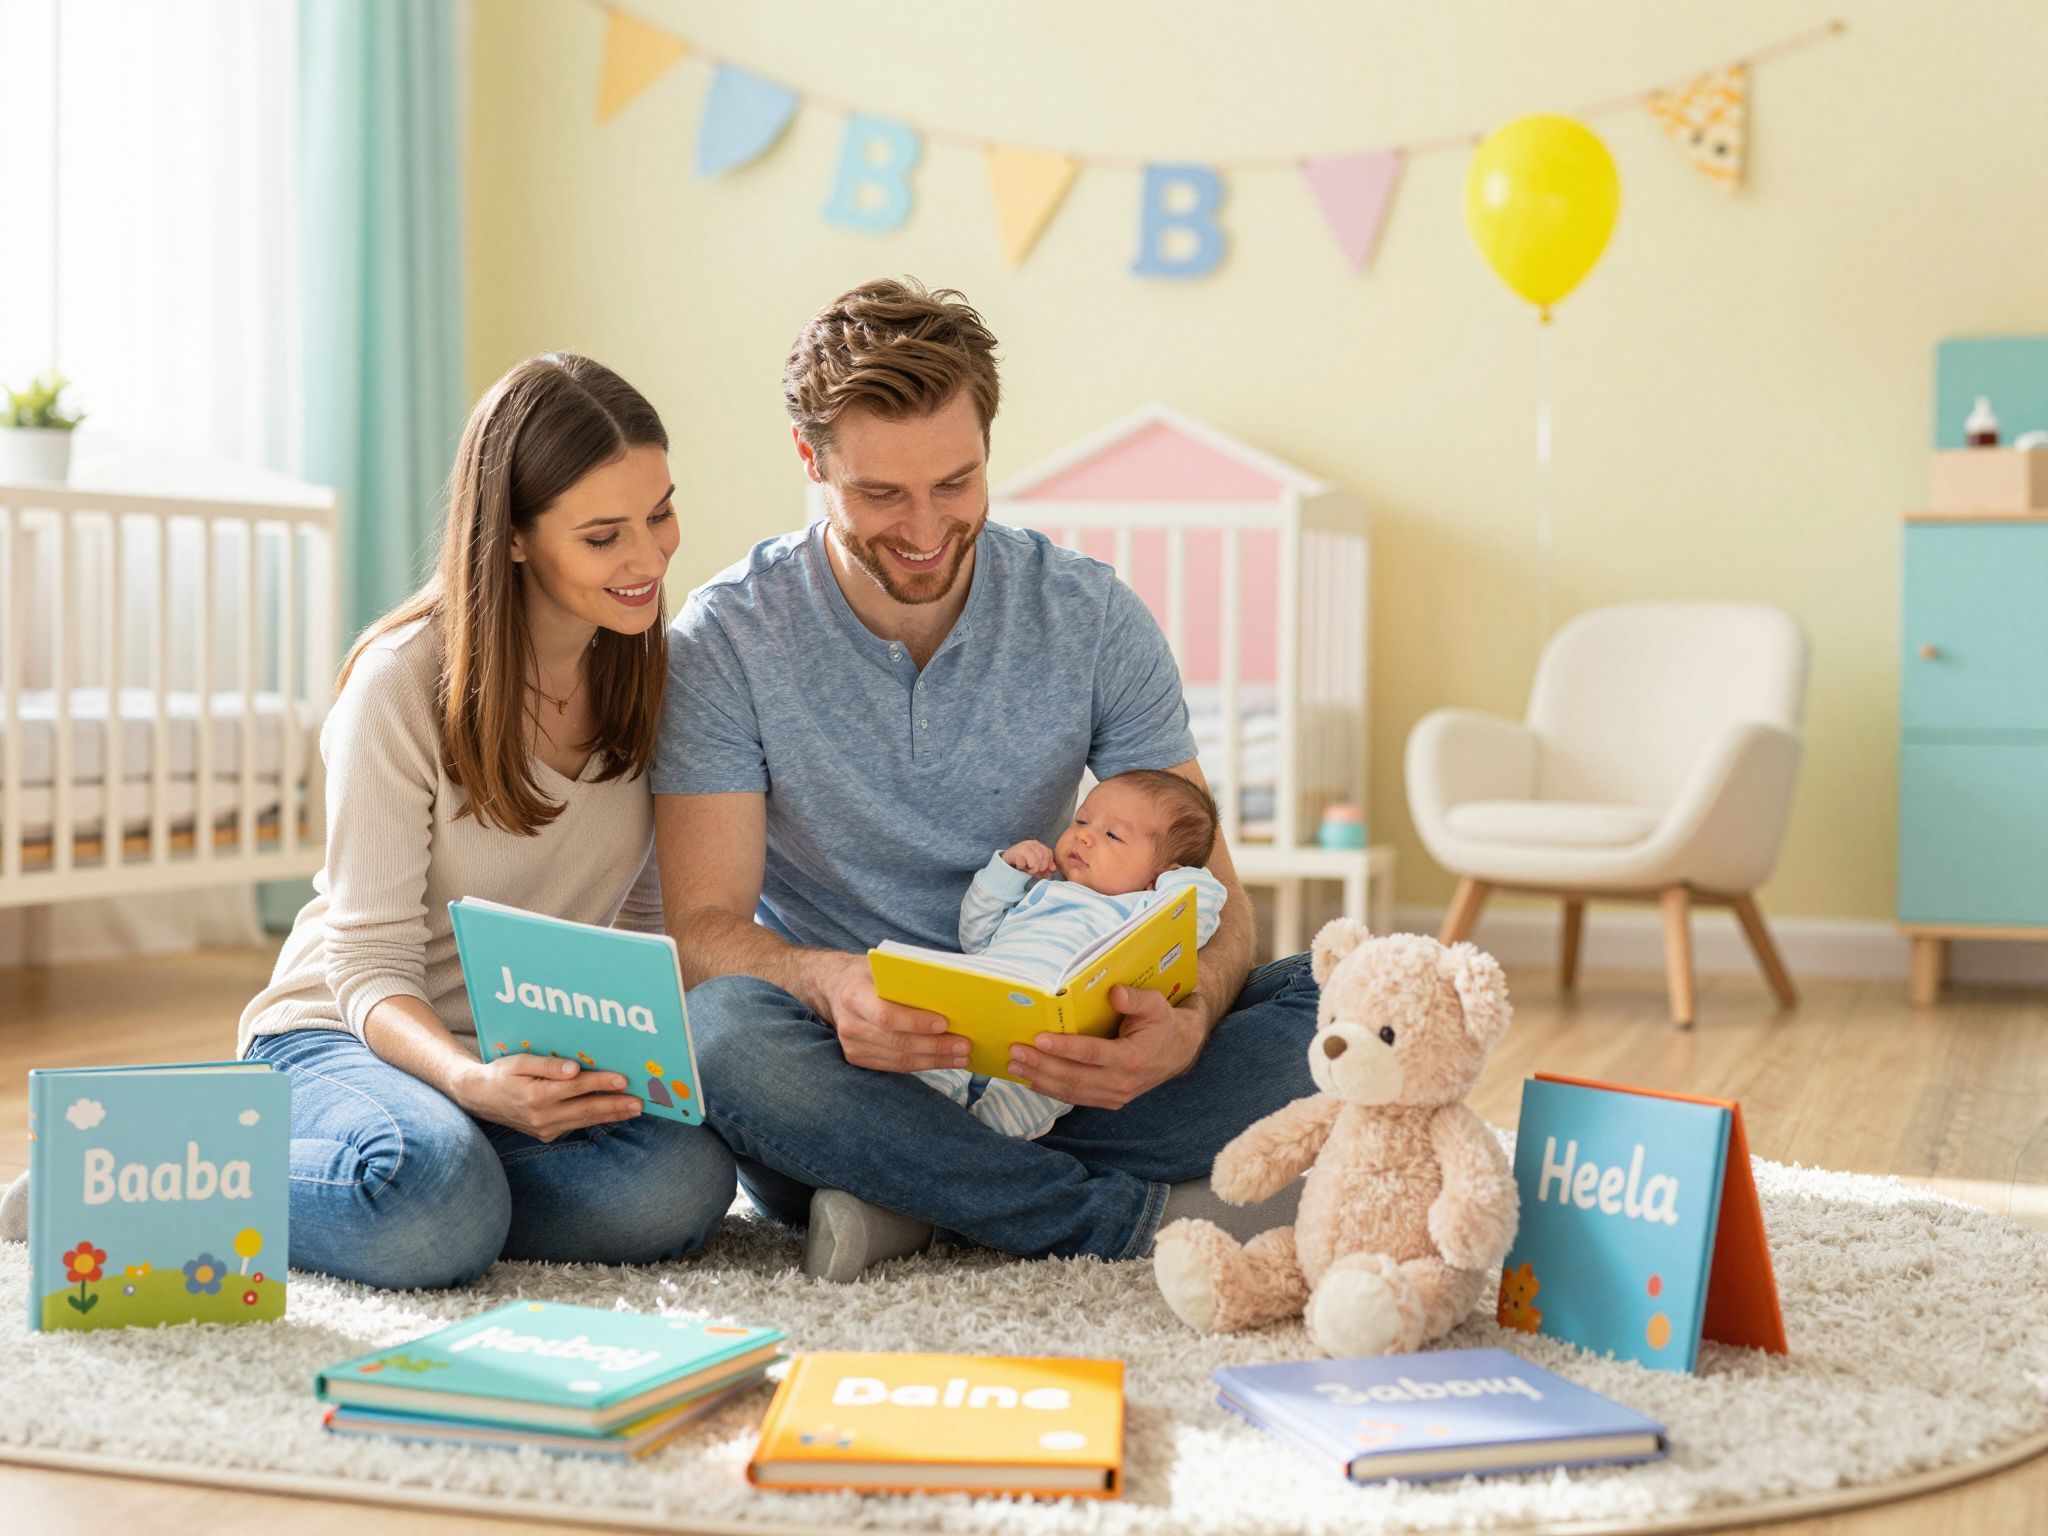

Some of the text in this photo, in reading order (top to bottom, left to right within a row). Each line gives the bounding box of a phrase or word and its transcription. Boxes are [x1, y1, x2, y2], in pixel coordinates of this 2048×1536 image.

[822, 112, 1229, 278] B B
[494, 966, 658, 1034] Jannna
[83, 1140, 253, 1205] Baaba
[1537, 1136, 1679, 1226] Heela
